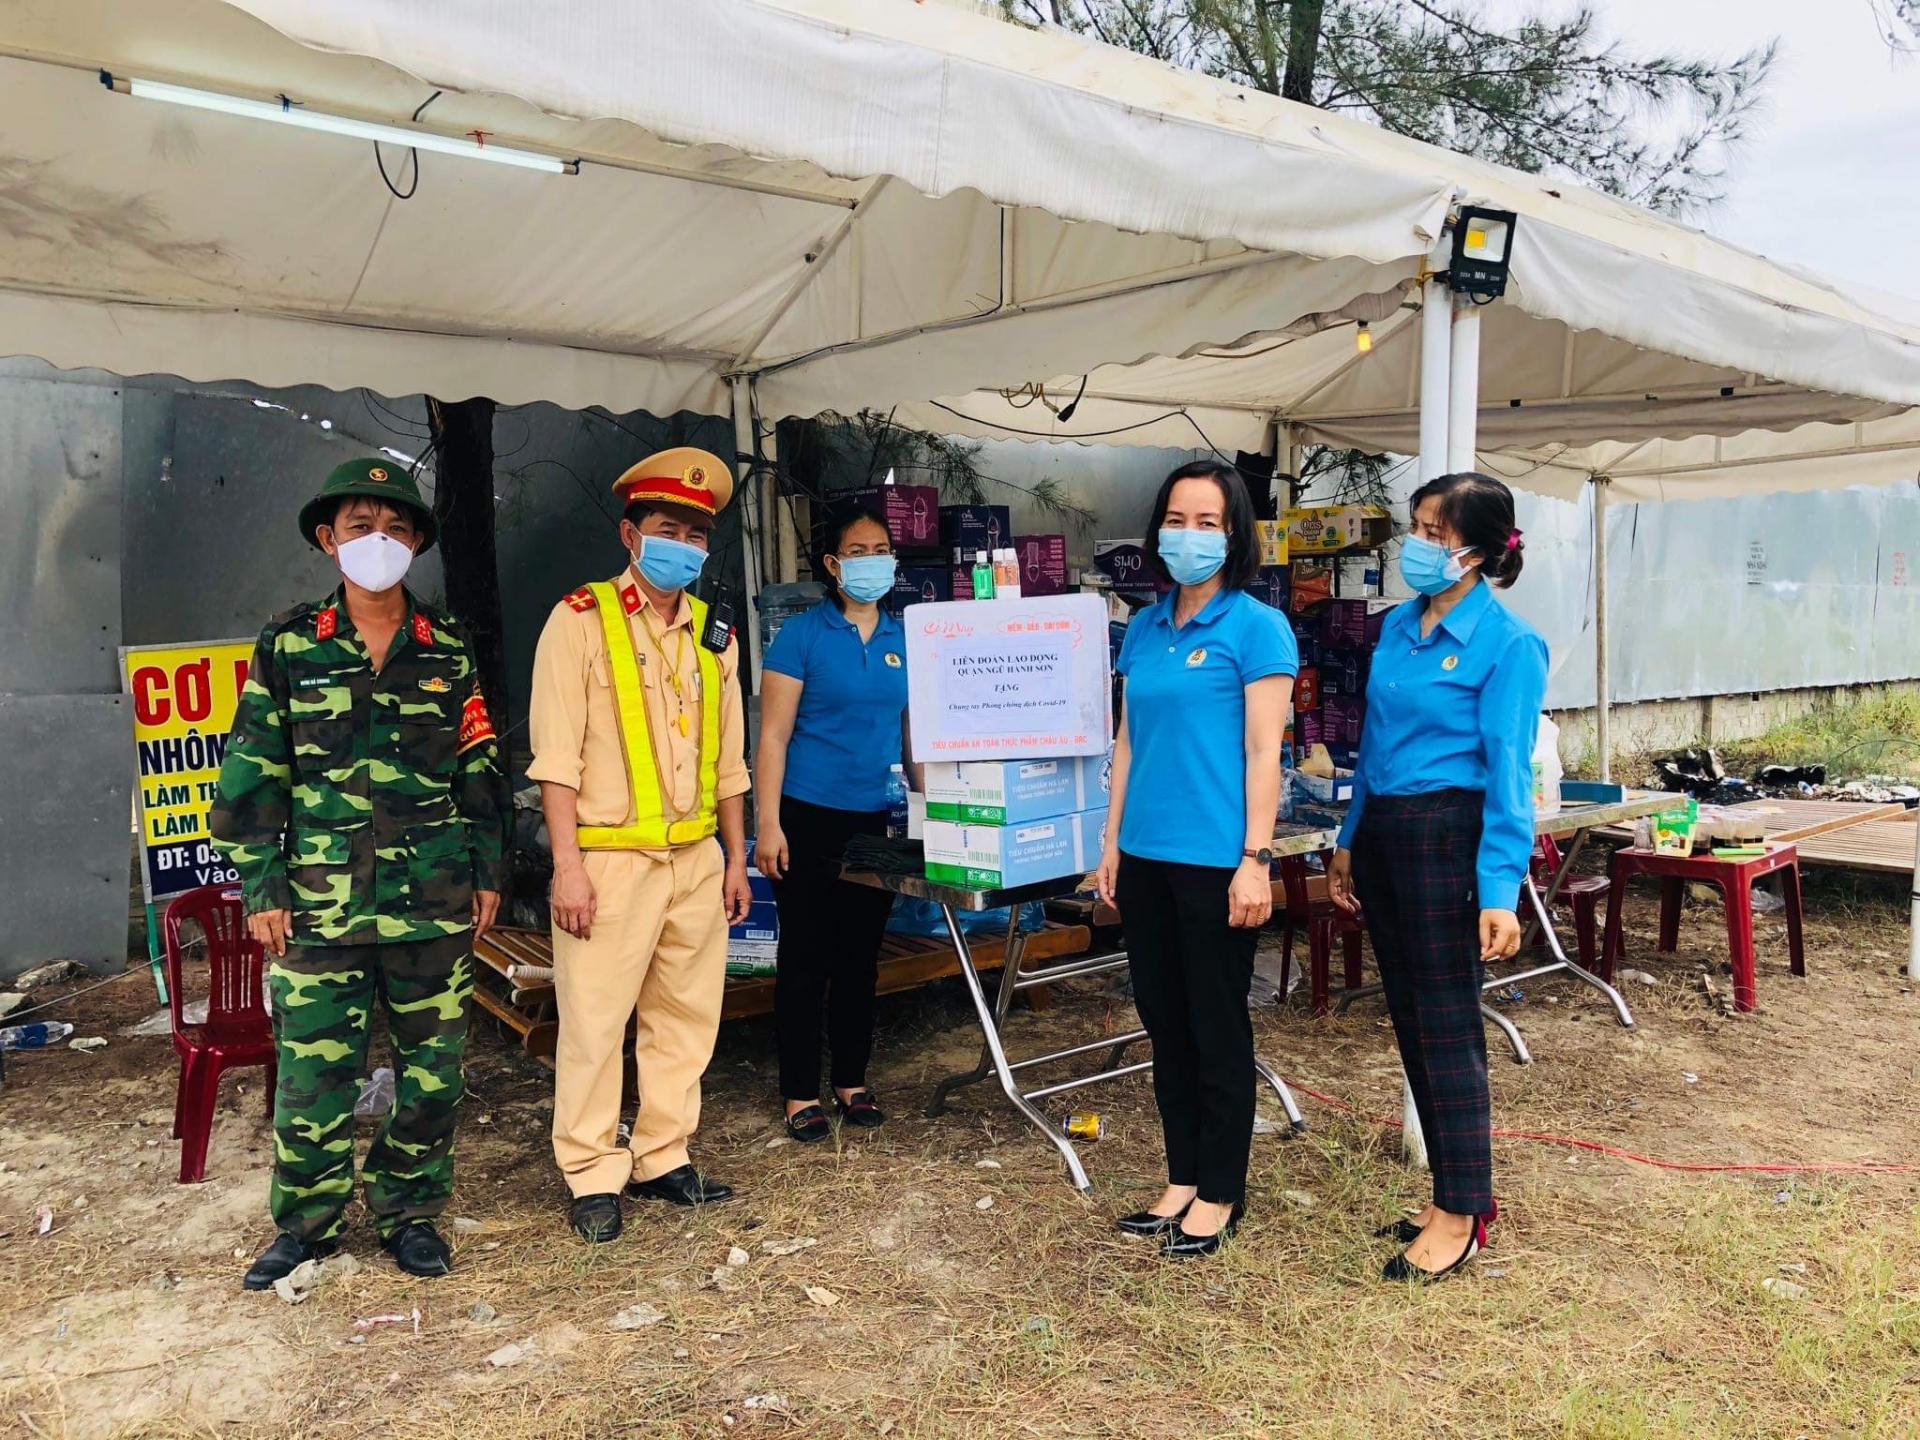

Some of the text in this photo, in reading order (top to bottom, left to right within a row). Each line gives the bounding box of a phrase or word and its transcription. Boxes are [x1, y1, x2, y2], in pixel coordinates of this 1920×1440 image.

[1007, 655, 1028, 664] LAO
[132, 657, 212, 727] CƠ
[949, 703, 969, 711] Chung
[1038, 699, 1067, 707] Covid-19
[138, 728, 230, 776] NHÔM
[144, 783, 190, 808] LÀM
[153, 813, 199, 837] LÀM
[157, 846, 190, 871] ĐT:
[195, 866, 240, 886] Vào
